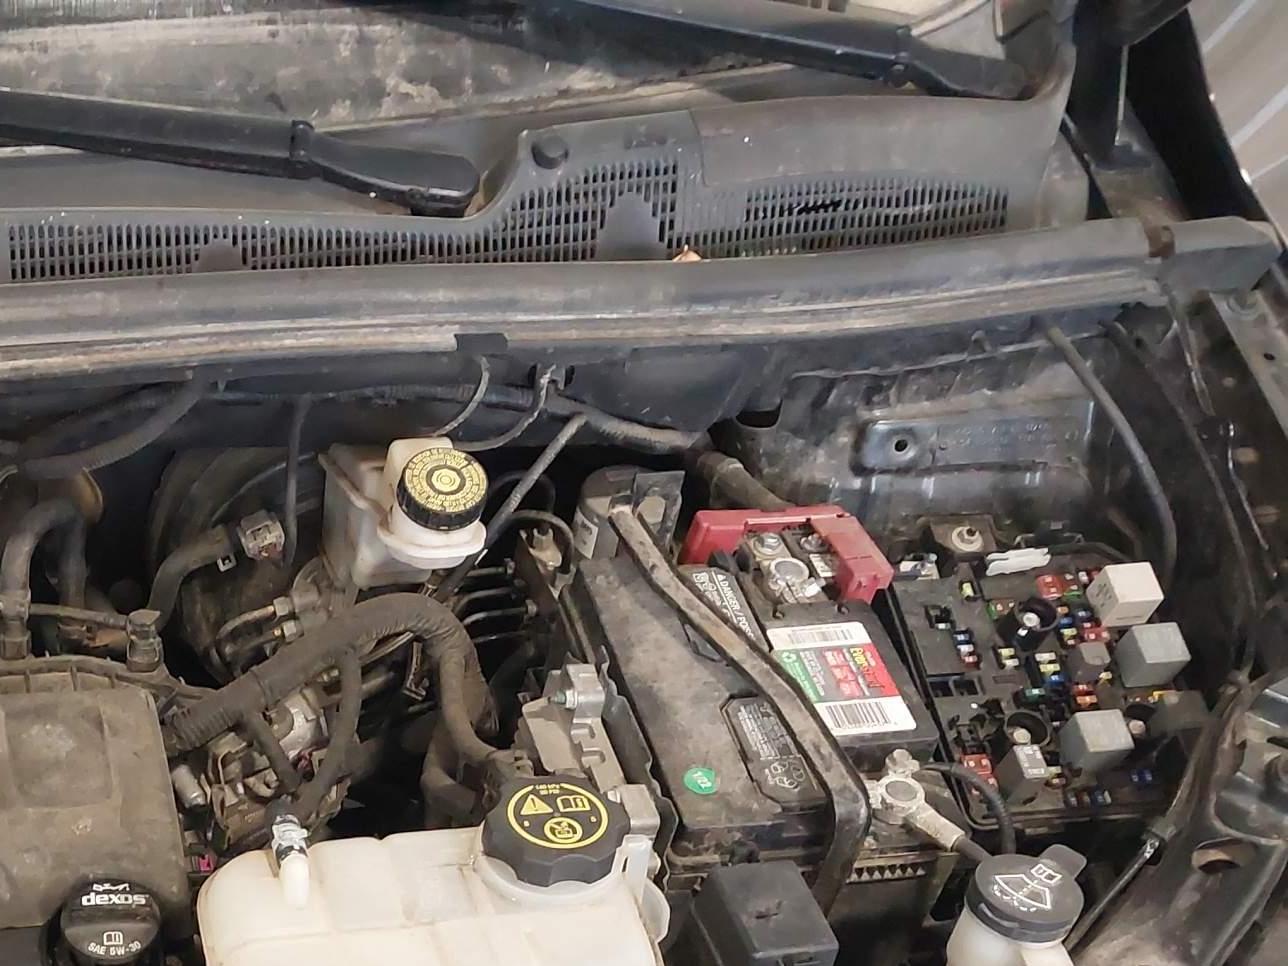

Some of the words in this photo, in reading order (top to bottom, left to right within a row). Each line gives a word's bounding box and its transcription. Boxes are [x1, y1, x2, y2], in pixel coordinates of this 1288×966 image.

[81, 892, 147, 906] dexos
[87, 942, 107, 956] SAE
[109, 940, 142, 956] 5W-30
